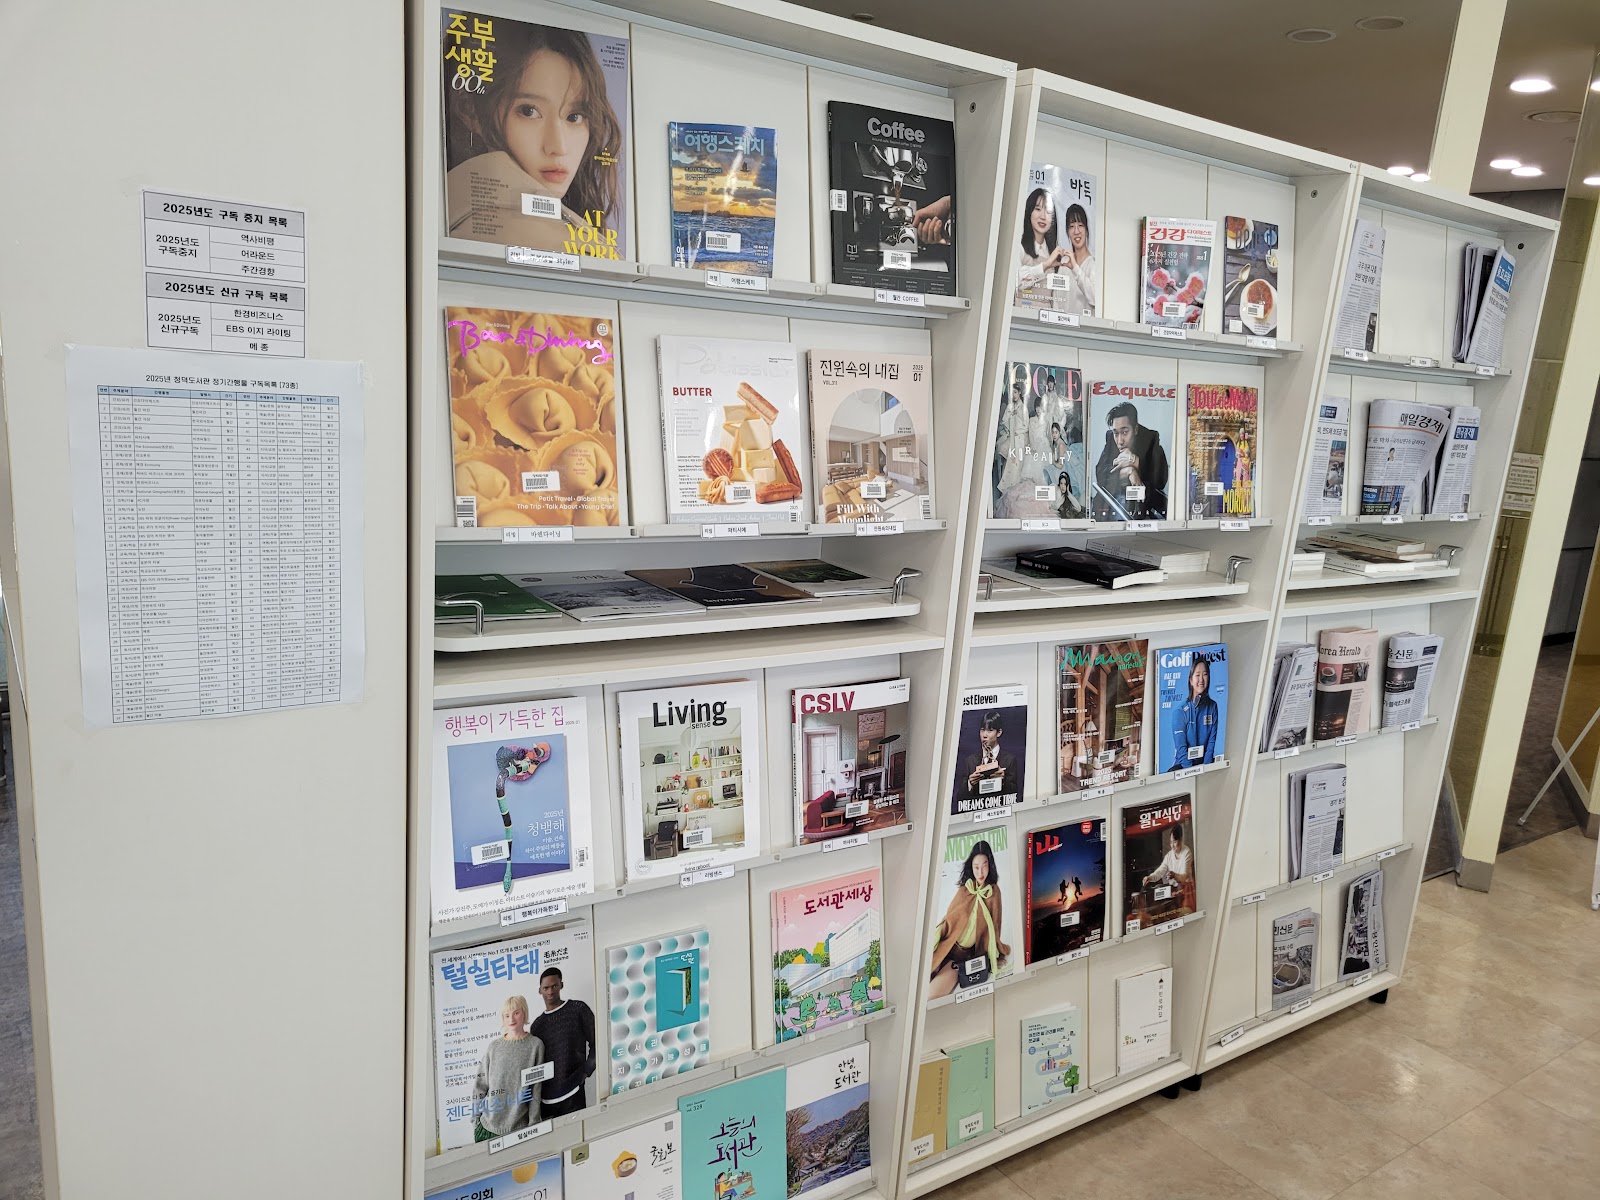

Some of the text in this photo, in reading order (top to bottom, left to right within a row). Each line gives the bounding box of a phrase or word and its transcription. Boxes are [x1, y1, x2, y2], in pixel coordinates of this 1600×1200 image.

[446, 13, 496, 49] 주부
[445, 45, 497, 83] 생활
[867, 117, 926, 143] Coffee
[684, 133, 764, 157] 여행스케치
[1035, 170, 1046, 182] 01
[1070, 178, 1092, 206] 바둑
[163, 203, 288, 228] 2025년도 구독 중지 목록
[581, 209, 605, 227] AT
[156, 234, 200, 247] 2025년도
[241, 234, 275, 246] 역사비평
[565, 223, 618, 247] YOUR
[1149, 227, 1187, 242] 건강
[158, 245, 197, 258] 구독중지
[241, 250, 275, 261] 어라운드
[563, 240, 620, 261] WORK
[241, 265, 275, 276] 주간경향
[731, 277, 756, 287] 여행스케치
[165, 281, 288, 303] 2025년도 신규 구독 목록
[902, 295, 920, 303] COFFEE
[158, 313, 201, 325] 2025년도
[234, 309, 284, 321] 한경비즈니스
[160, 324, 199, 336] 신규구독
[226, 325, 291, 338] EBS 이지 라이팅
[260, 343, 269, 351] 종
[820, 359, 900, 380] 전원속의 내집
[913, 372, 922, 382] 01
[145, 375, 171, 383] 2025년
[212, 378, 248, 387] 정기간행물
[1002, 361, 1082, 401] OGE
[672, 387, 712, 397] BUTTER
[1092, 381, 1176, 400] Esquire
[1400, 413, 1444, 434] 매일경제
[529, 503, 542, 511] Trip
[581, 503, 600, 511] Young
[836, 503, 880, 514] Fill With
[1338, 645, 1362, 657] Herald
[1160, 651, 1192, 669] Golf
[800, 691, 856, 715] CSLV
[652, 698, 728, 728] Living
[445, 705, 565, 738] 행복이 가득한 집
[691, 720, 711, 730] sense
[1080, 769, 1127, 787] TREND REPORT
[958, 793, 1018, 812] DREAMS COME TRUE
[527, 818, 565, 837] 청뱀해
[704, 870, 723, 878] 리빙센스
[803, 884, 874, 916] 도서관세상
[438, 907, 455, 916] 사진가
[521, 904, 559, 918] 행복이가득한집
[487, 948, 500, 957] No.1
[441, 948, 539, 991] 털실타래
[837, 1057, 856, 1073] 안녕,
[834, 1070, 862, 1090] 도서관
[446, 1095, 471, 1106] 3사이즈로
[517, 1127, 539, 1140] 털실타래
[709, 1115, 756, 1140] 오늘의
[707, 1132, 763, 1170] 도서관
